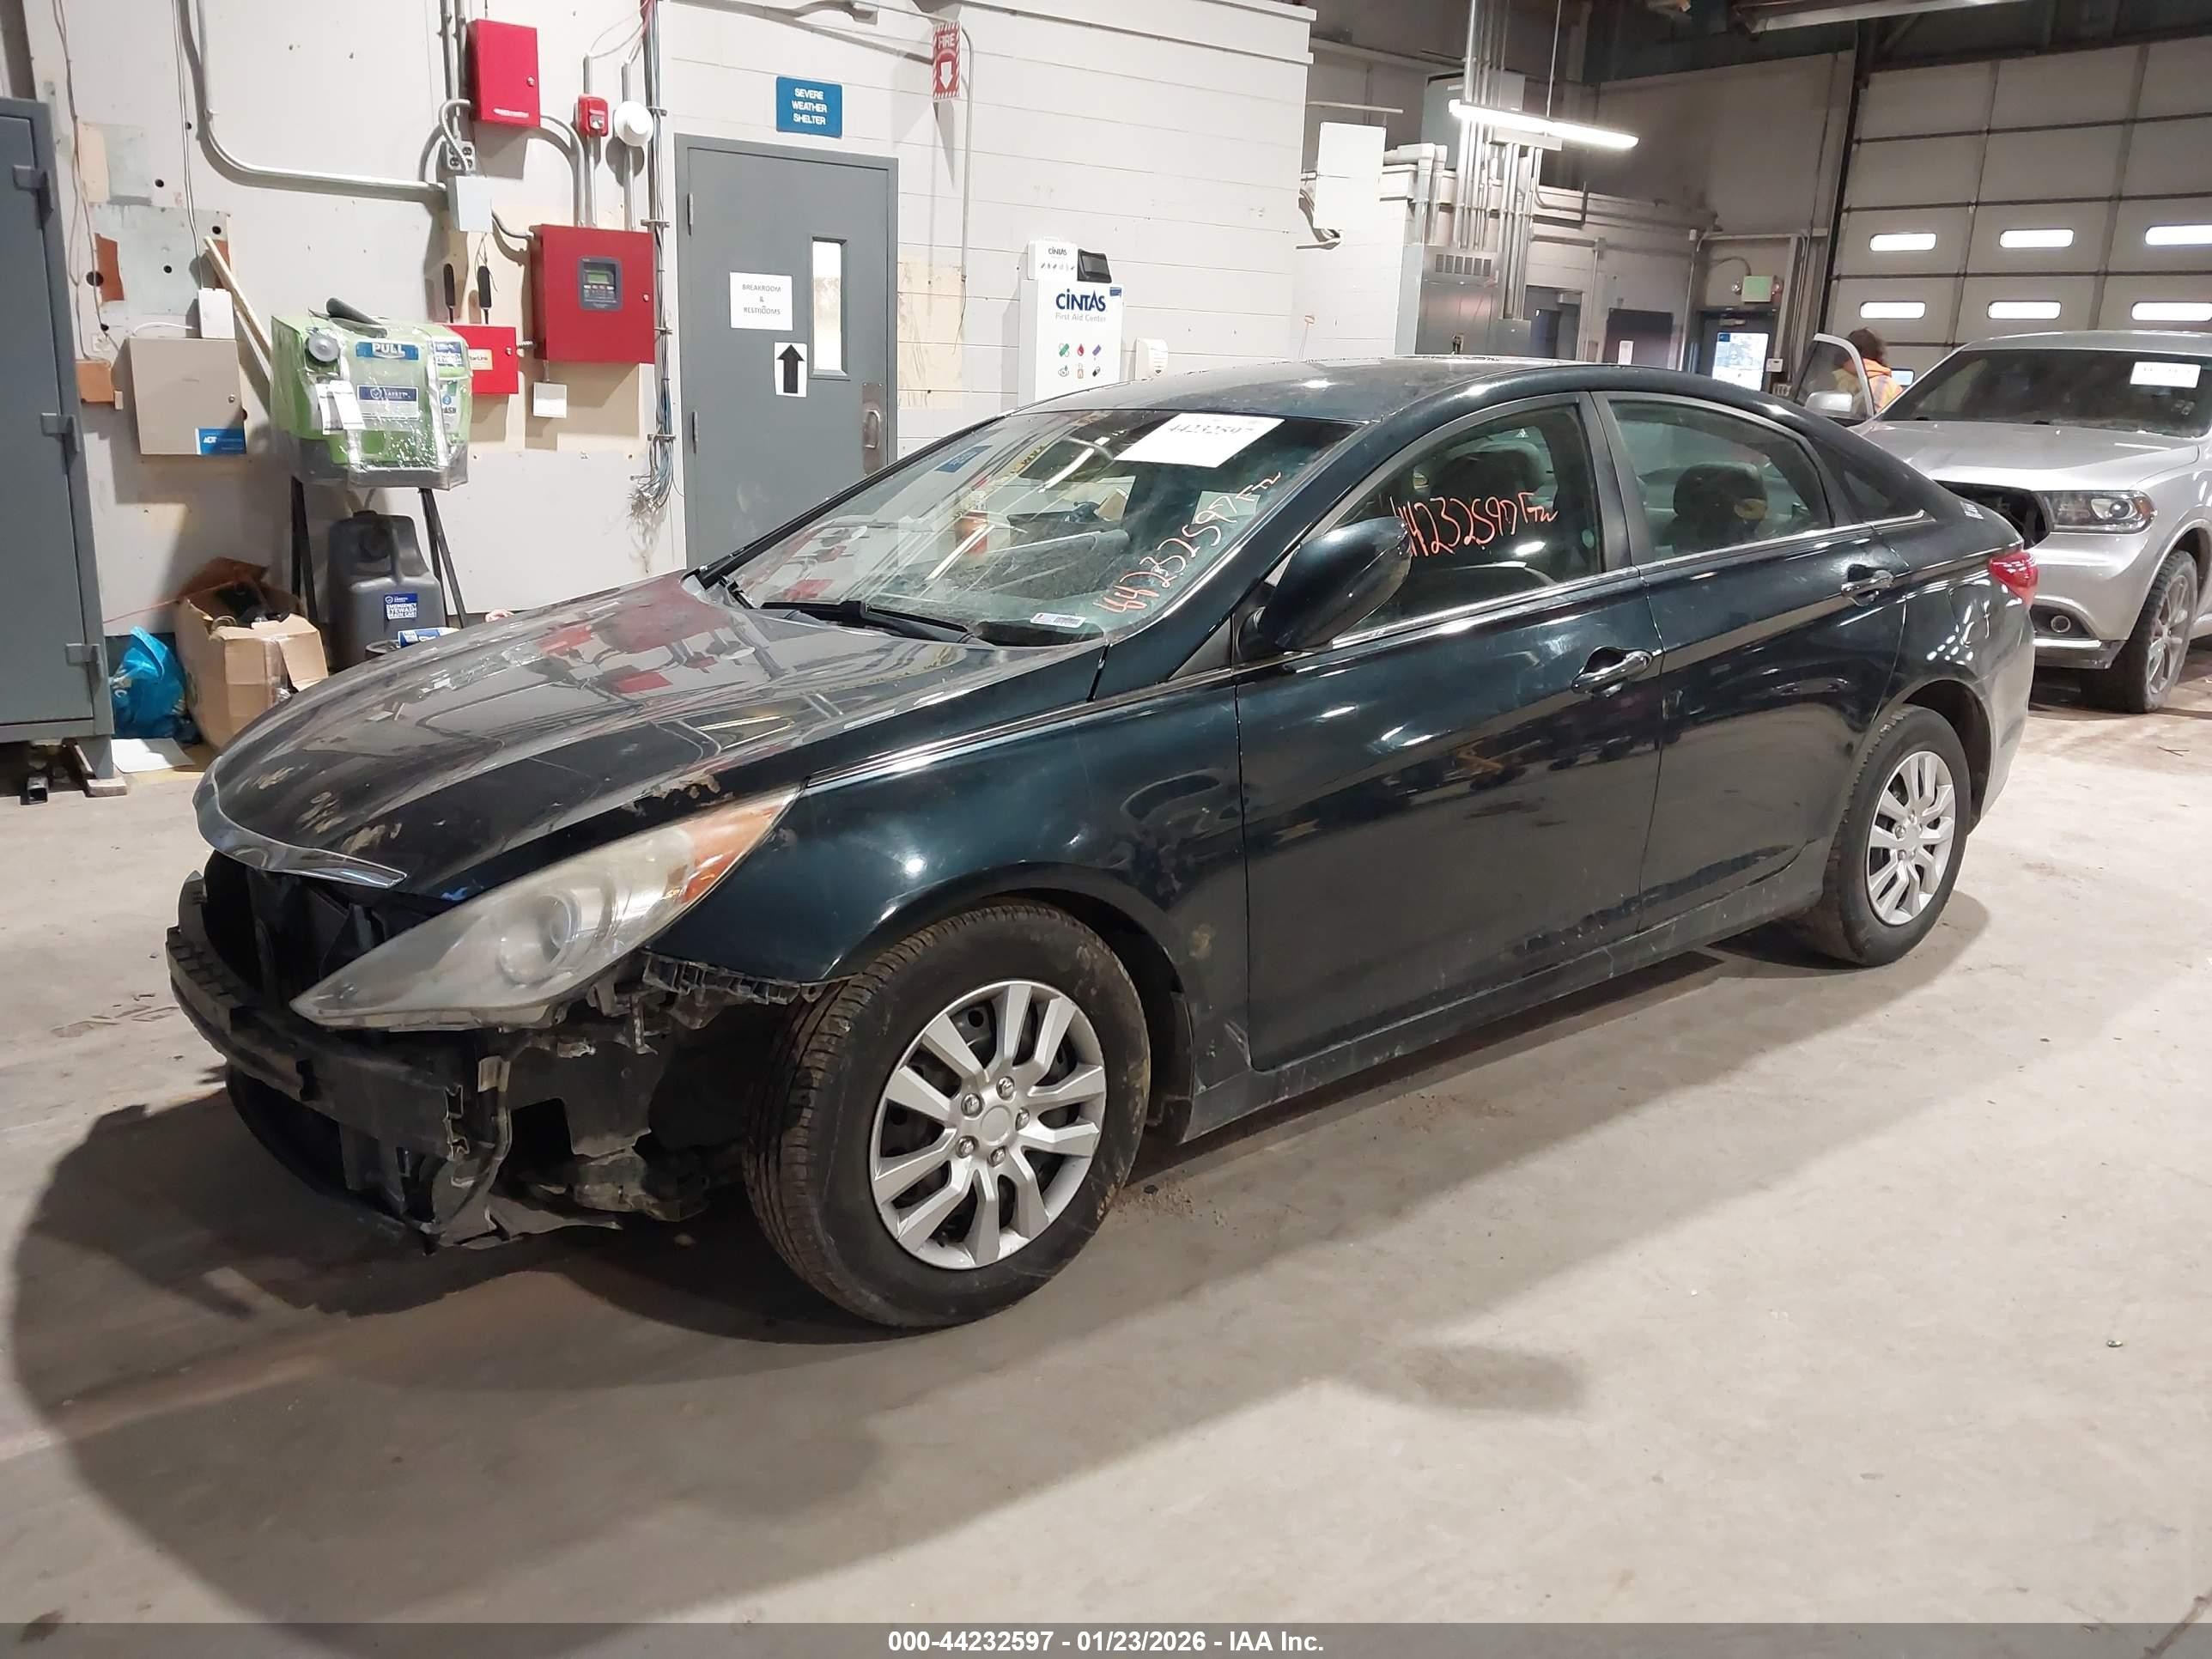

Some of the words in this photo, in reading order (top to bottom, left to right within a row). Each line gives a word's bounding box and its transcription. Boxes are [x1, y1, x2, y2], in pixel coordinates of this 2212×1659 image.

[938, 33, 956, 49] FIRE
[794, 88, 824, 100] SEVERE
[791, 100, 828, 113] WEATHER
[793, 112, 826, 125] SHELTER
[742, 283, 781, 293] BREAKROOM
[1055, 288, 1107, 313] CINTAS
[743, 307, 781, 315] RESTROOMS
[1055, 313, 1070, 321] First
[1072, 313, 1084, 322] Aid
[1085, 314, 1106, 323] Center
[372, 343, 405, 355] PULL
